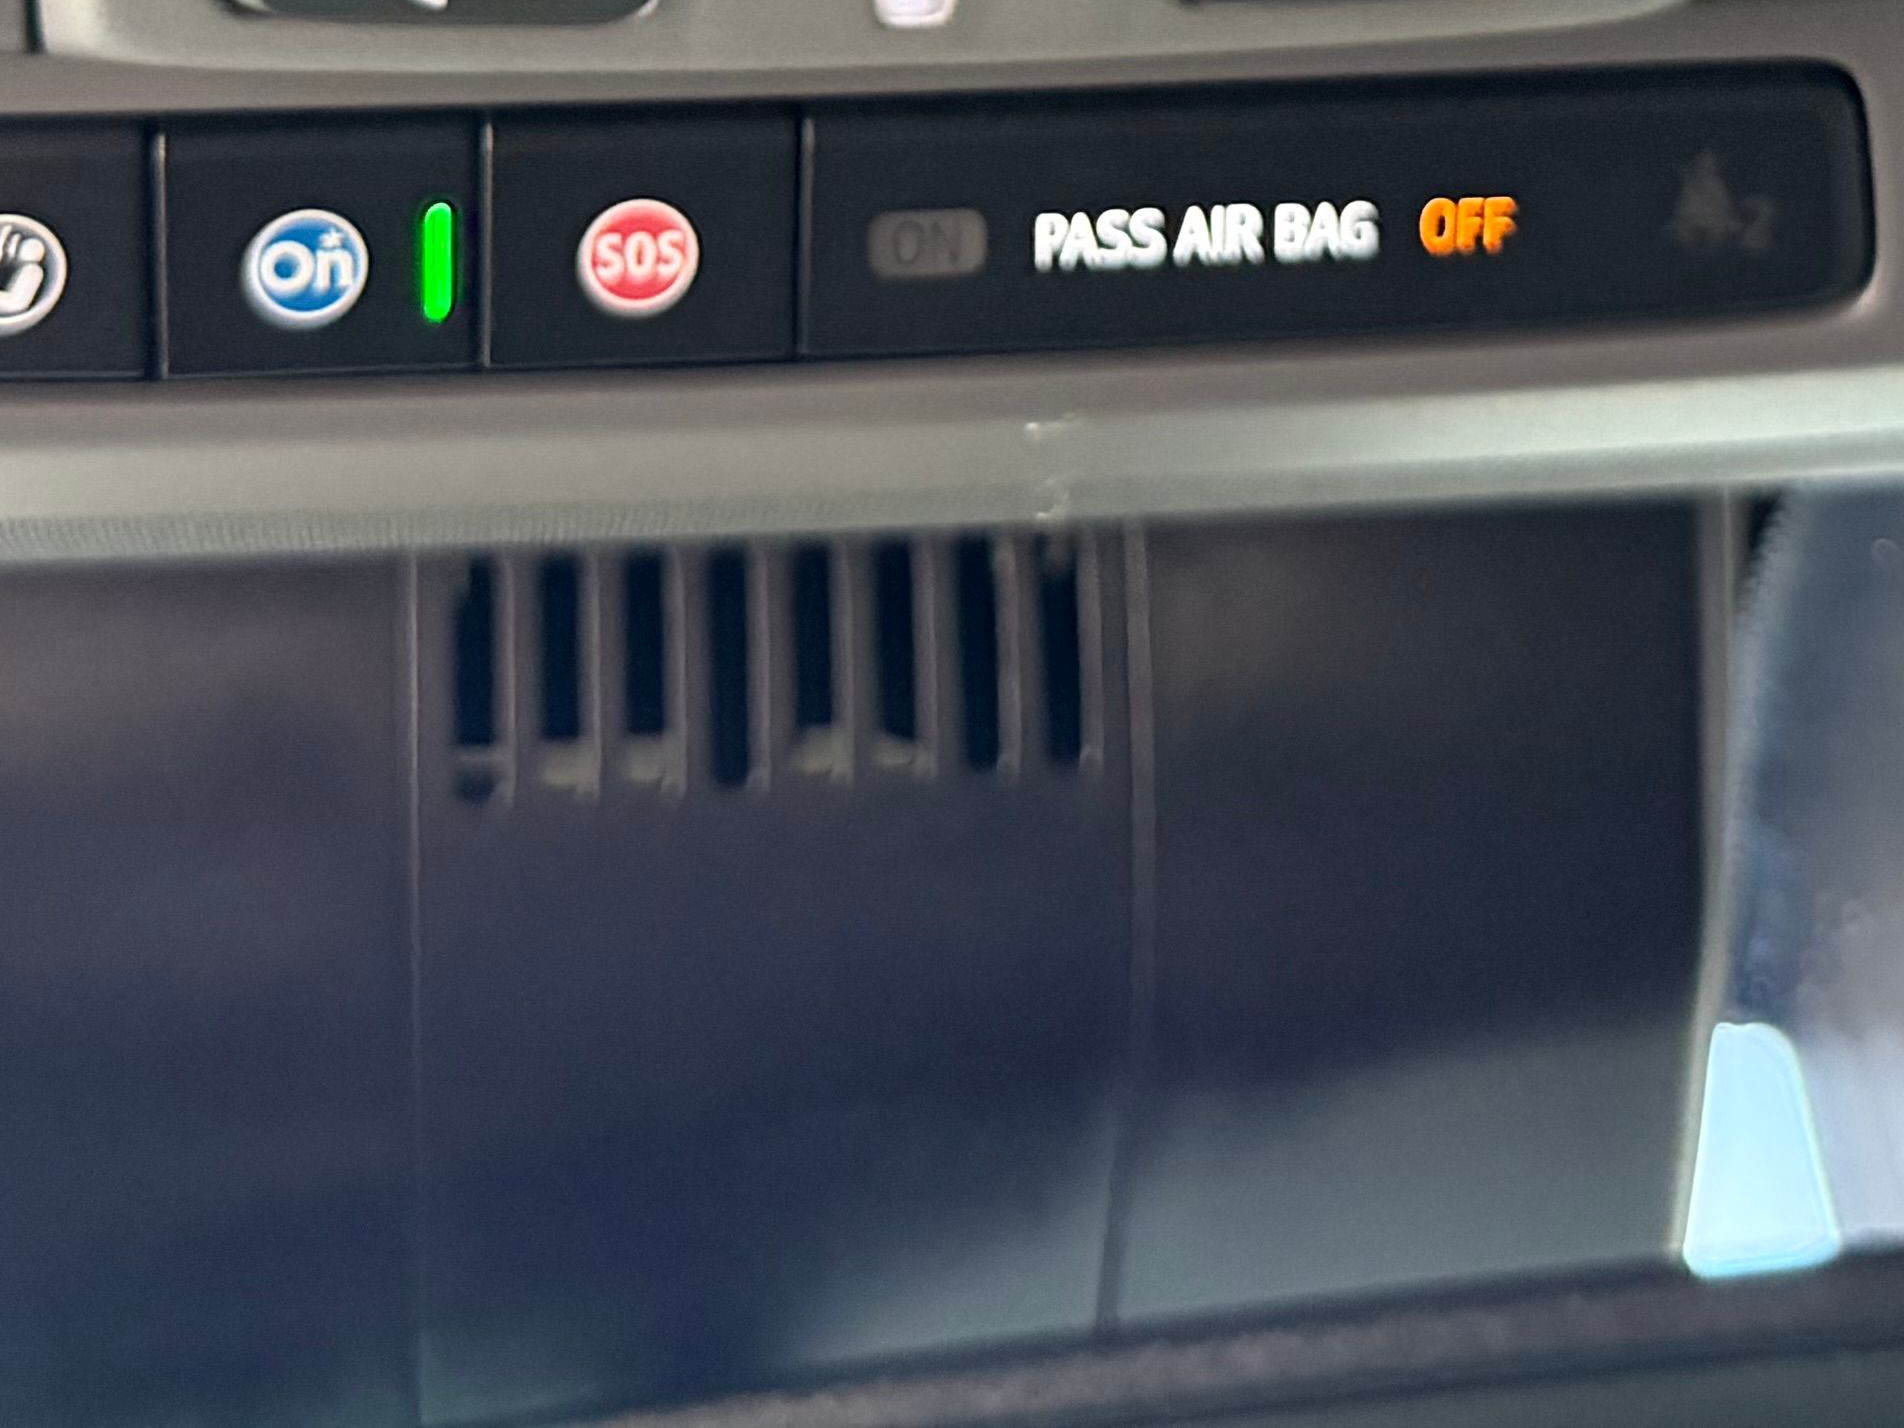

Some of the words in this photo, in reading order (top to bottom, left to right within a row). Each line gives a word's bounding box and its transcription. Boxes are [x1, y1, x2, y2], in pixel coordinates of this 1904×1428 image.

[594, 229, 685, 279] SOS
[1033, 206, 1167, 272] PASS
[1173, 203, 1266, 266] AIR
[1273, 200, 1381, 261] BAG
[1418, 196, 1520, 256] OFF
